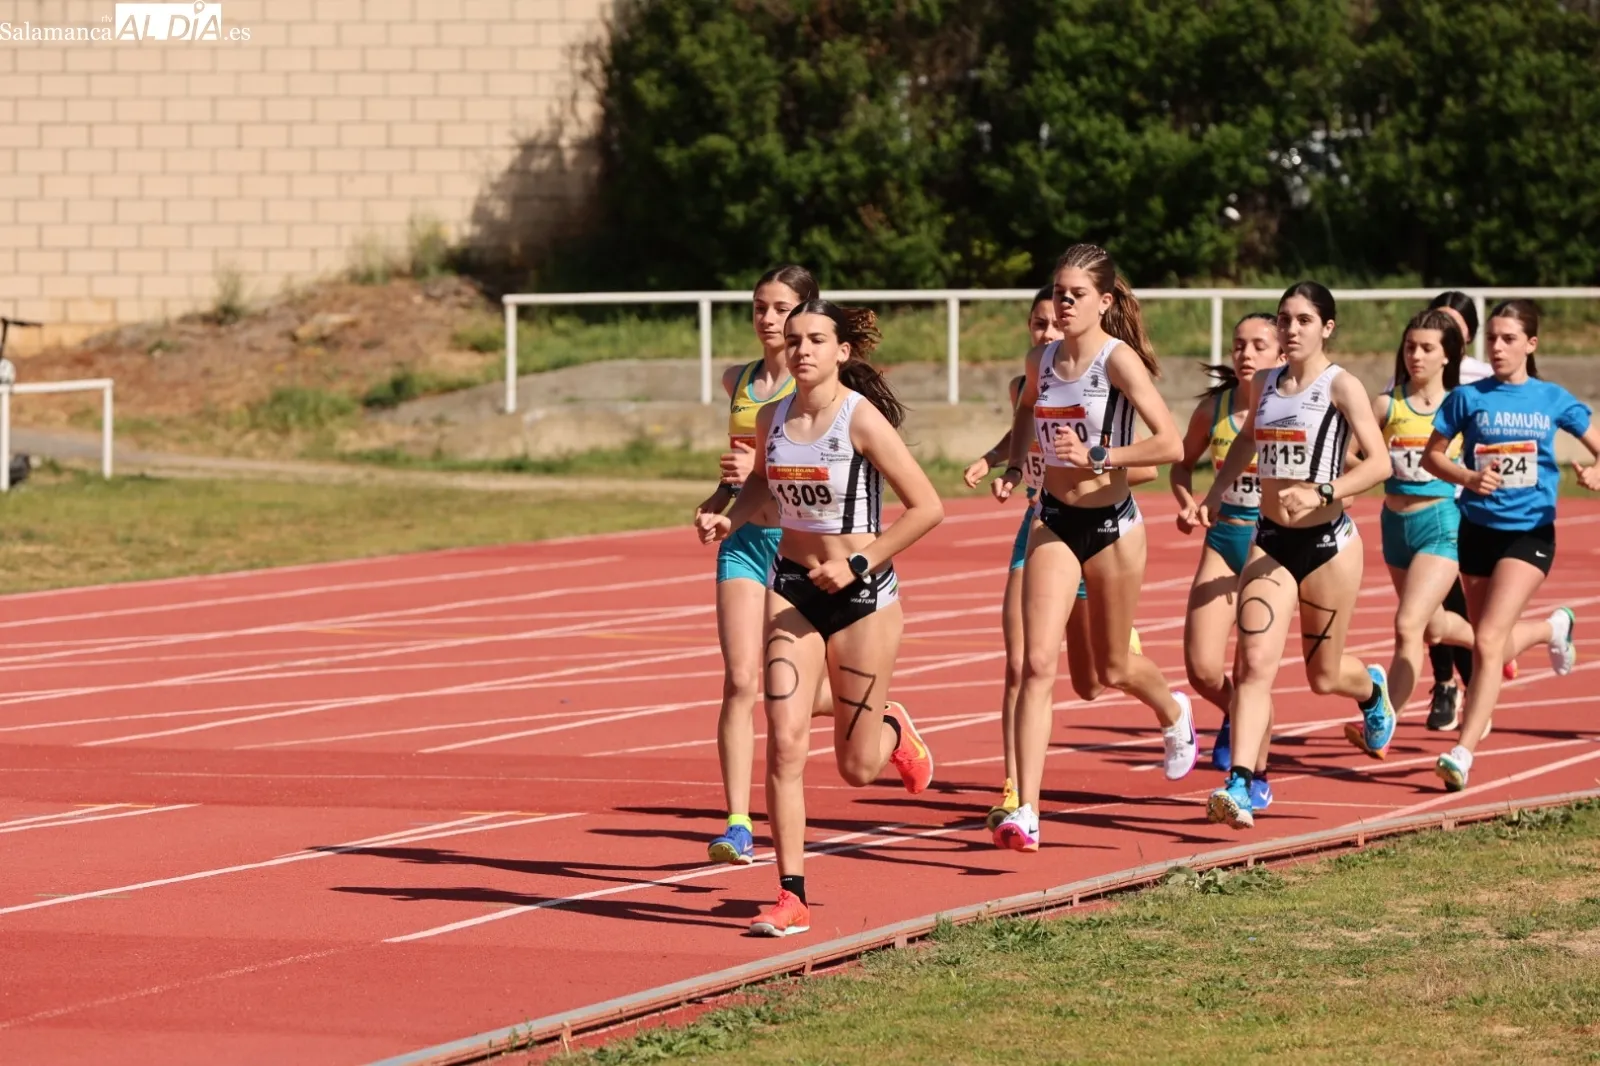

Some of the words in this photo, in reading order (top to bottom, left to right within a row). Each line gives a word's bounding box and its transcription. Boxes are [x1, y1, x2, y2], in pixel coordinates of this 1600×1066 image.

[1476, 411, 1490, 427] LA
[1495, 411, 1551, 430] ARMUÑA
[1041, 421, 1088, 443] 10
[1481, 427, 1501, 436] CLUB
[1503, 428, 1547, 439] DEPORTIVO
[1262, 444, 1306, 465] 1315
[1025, 456, 1046, 477] 15
[777, 484, 832, 506] 1309
